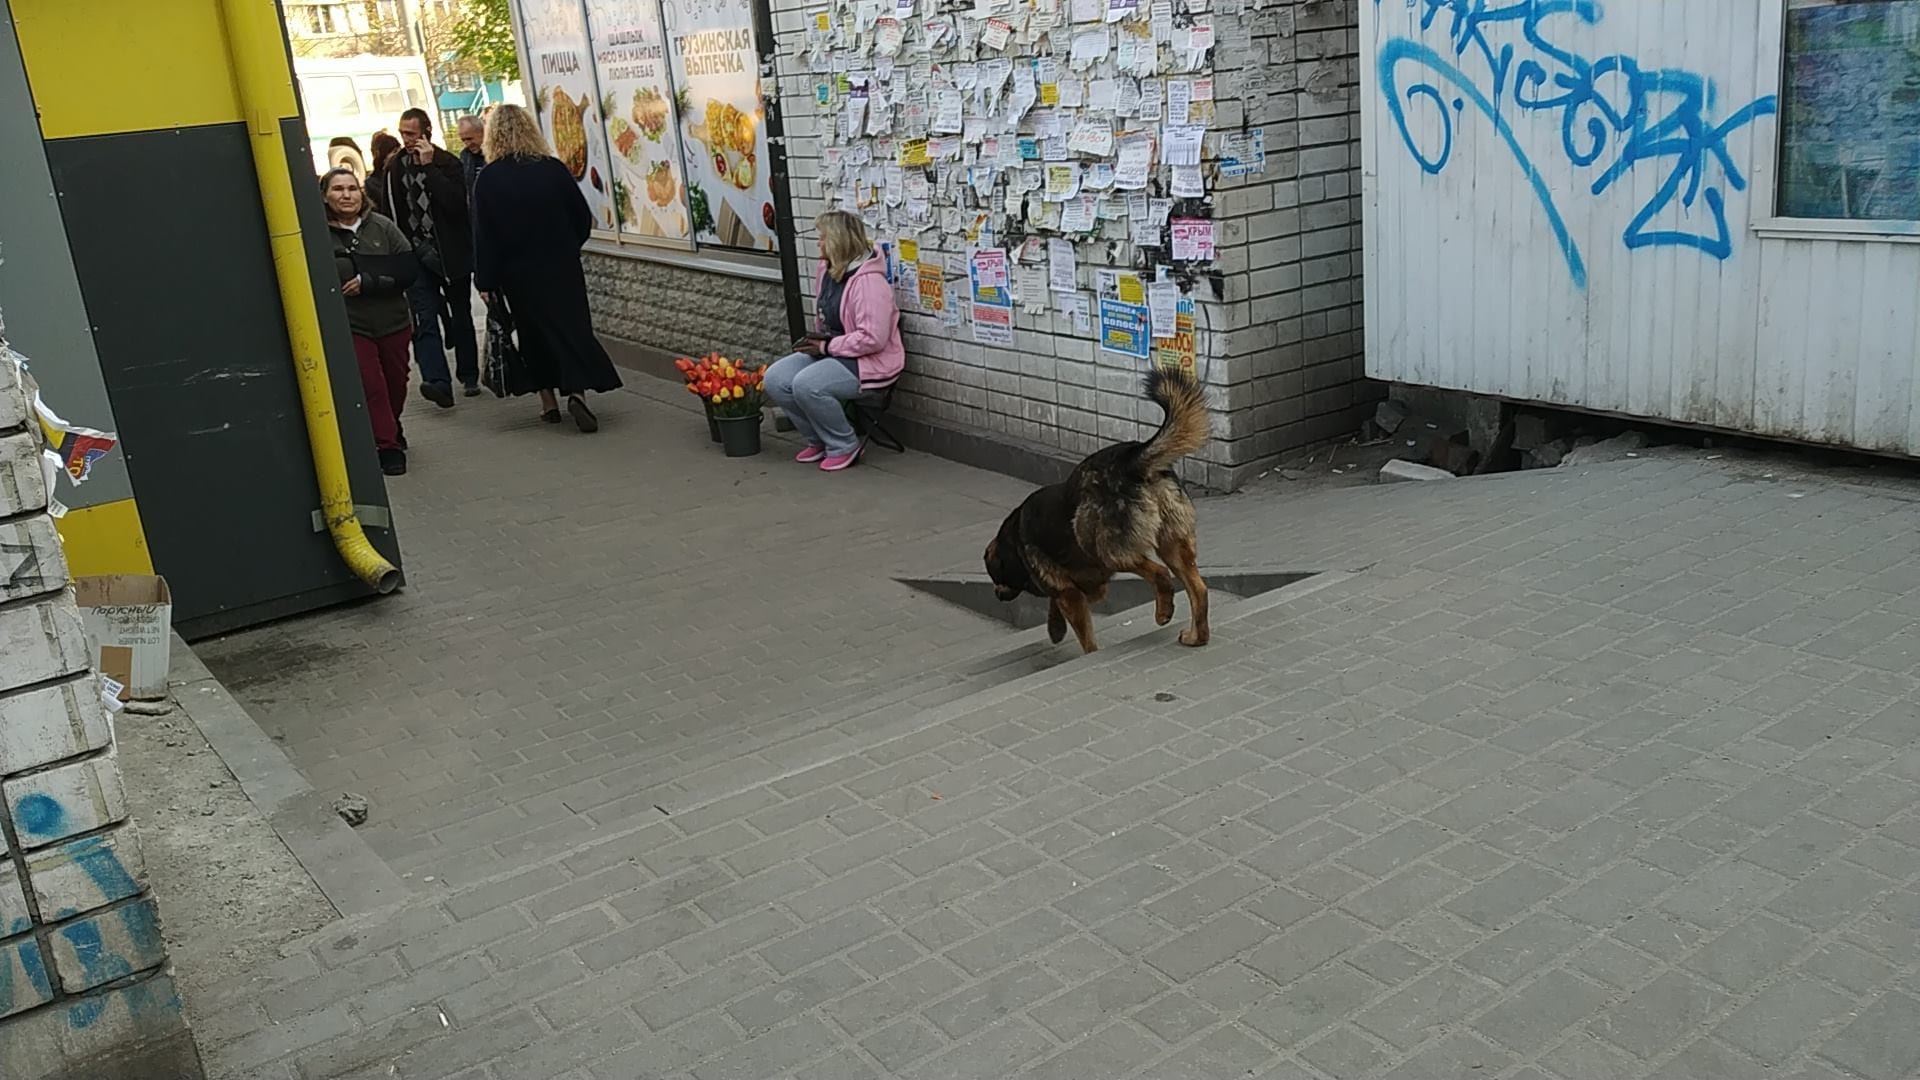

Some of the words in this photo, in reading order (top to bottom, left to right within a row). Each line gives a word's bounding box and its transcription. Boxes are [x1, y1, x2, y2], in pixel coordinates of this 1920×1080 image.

[608, 29, 644, 46] ШАШЛЫК
[673, 28, 750, 56] ГРУЗИНСКАЯ
[629, 45, 662, 61] МАНГАЛЕ
[541, 51, 580, 76] ПИЦЦА
[608, 64, 655, 80] ЛЮЛЯ-КЕБАБ
[685, 52, 745, 76] ВЫПЕЧКА
